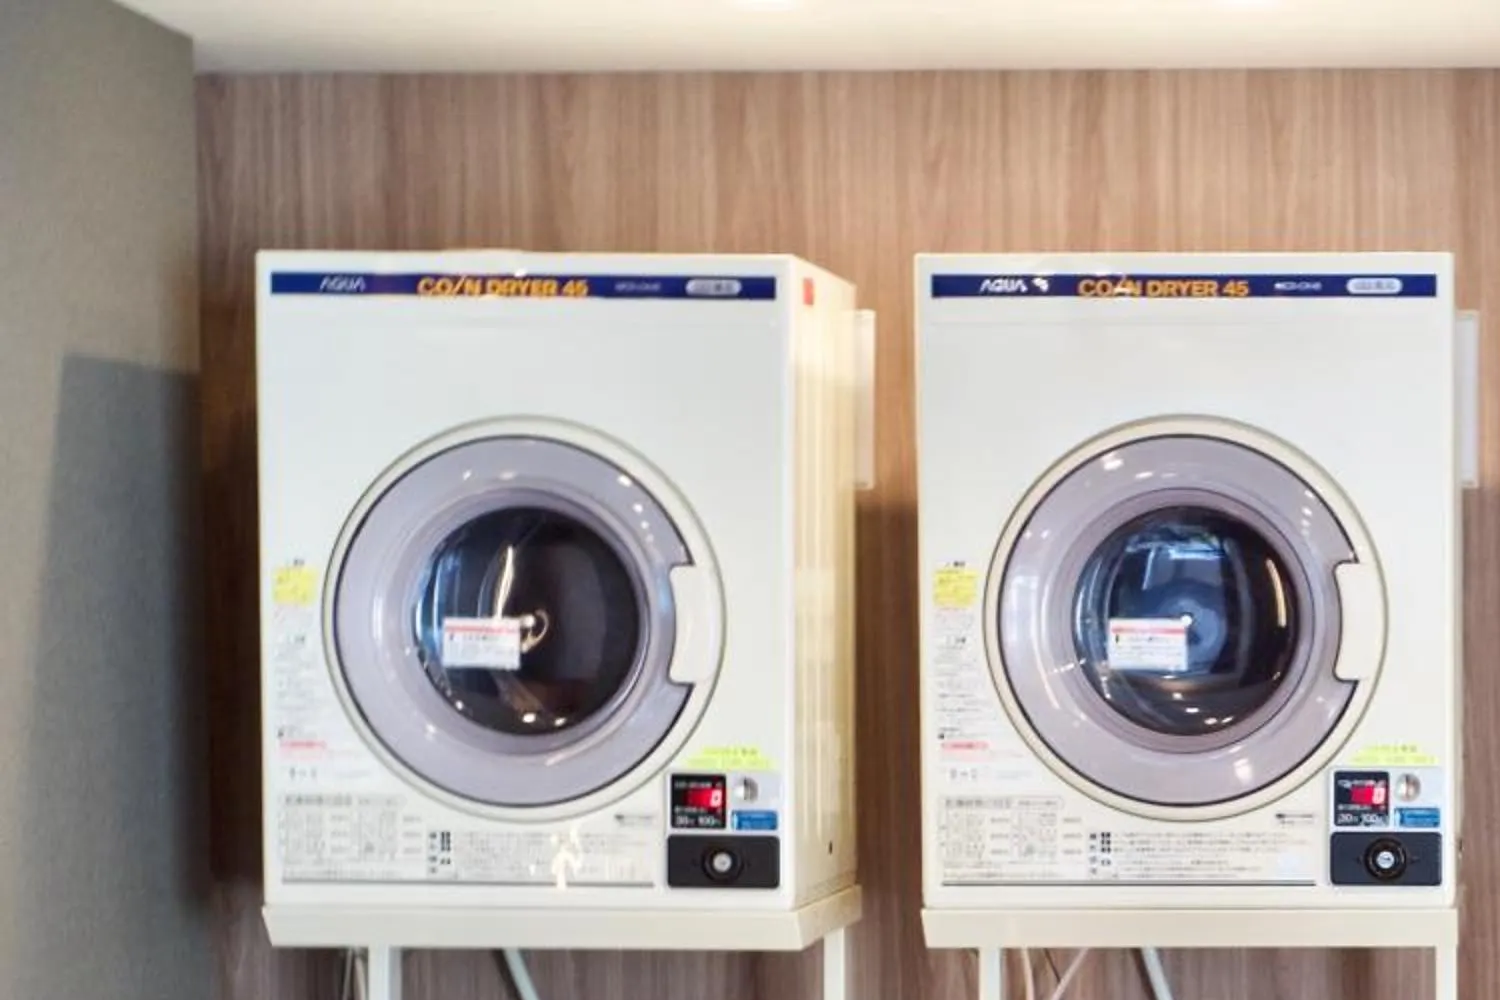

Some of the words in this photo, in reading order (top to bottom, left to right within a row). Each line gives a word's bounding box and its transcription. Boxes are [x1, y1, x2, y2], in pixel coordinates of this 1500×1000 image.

[487, 276, 557, 297] DRYER
[562, 277, 589, 297] 45
[979, 278, 1028, 293] AQUA
[1146, 279, 1218, 297] DRYER
[1222, 280, 1249, 297] 45
